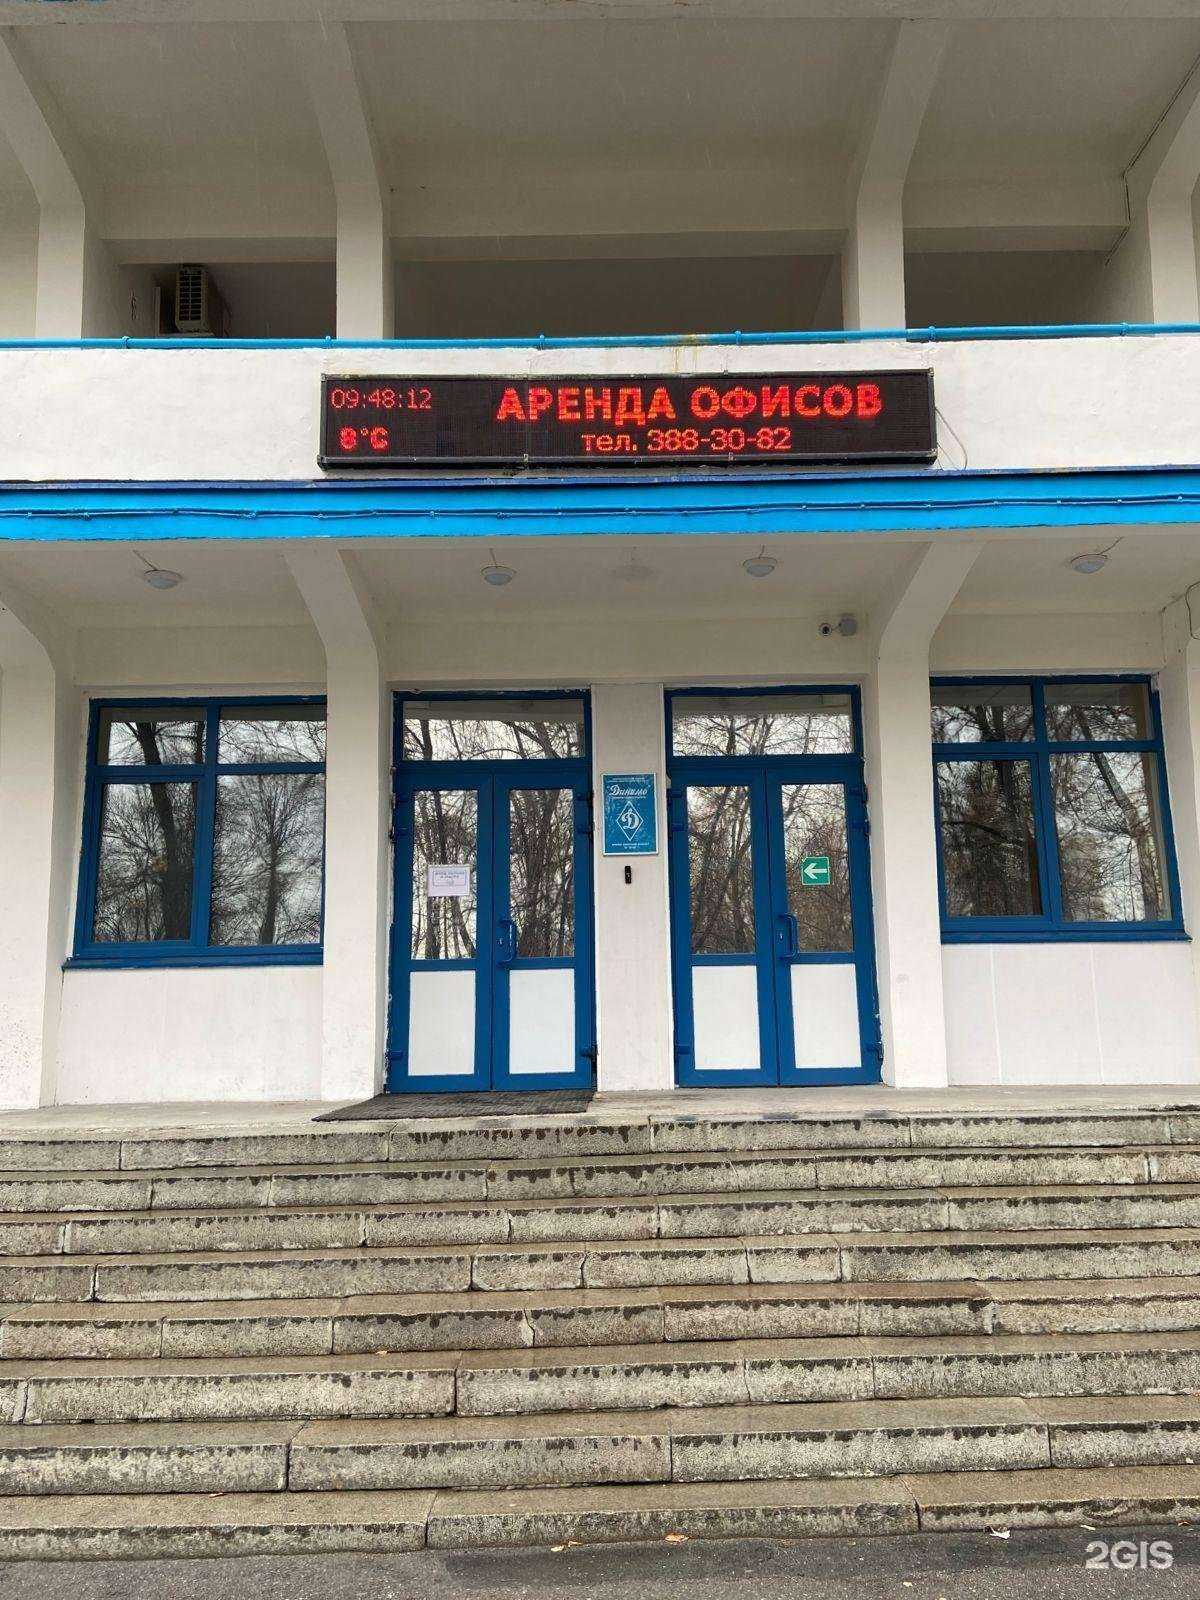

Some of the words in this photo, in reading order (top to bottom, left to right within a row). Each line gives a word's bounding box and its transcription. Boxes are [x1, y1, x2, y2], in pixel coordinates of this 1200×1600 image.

[331, 388, 432, 409] 09:48:12
[497, 386, 676, 425] АРЕНДА
[691, 384, 882, 418] ОФИСОВ
[581, 434, 638, 452] тел.
[647, 427, 792, 451] 388-30-82
